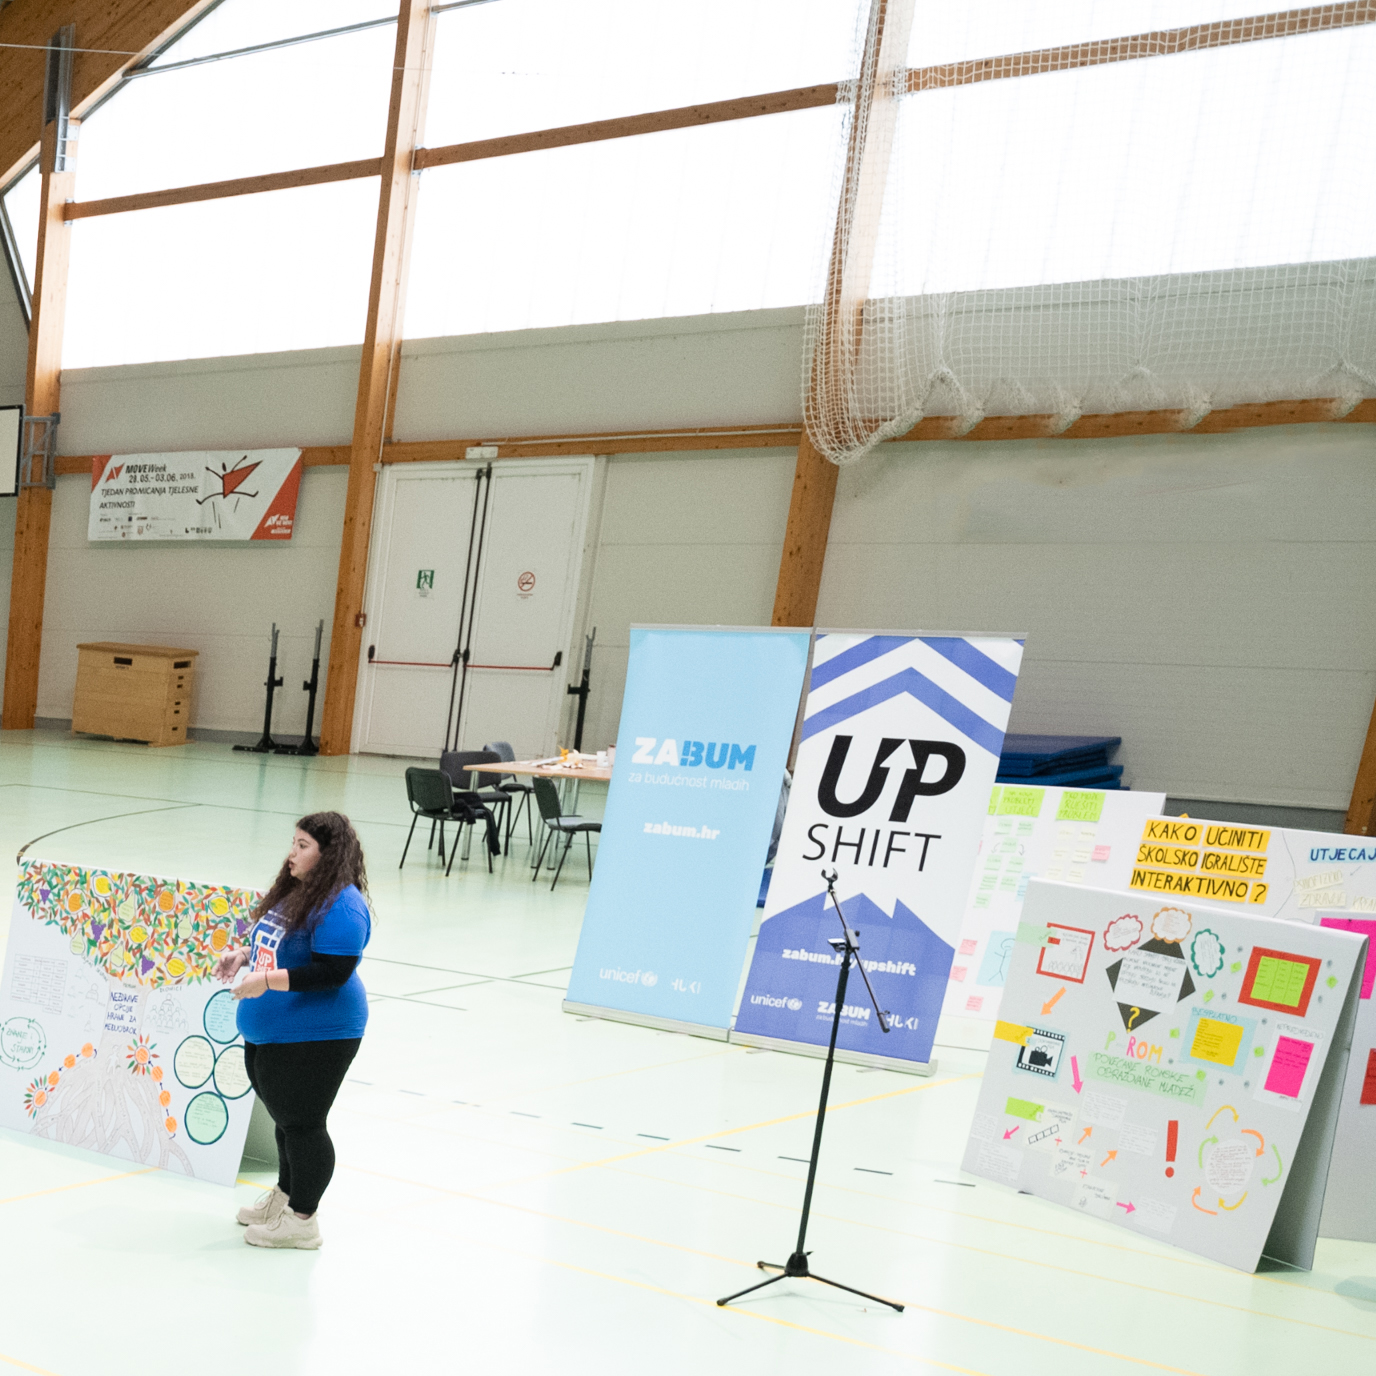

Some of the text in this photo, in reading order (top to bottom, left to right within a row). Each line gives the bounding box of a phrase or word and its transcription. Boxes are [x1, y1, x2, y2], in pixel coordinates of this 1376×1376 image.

[101, 485, 199, 498] TJEDAN PROMICANJA TJELESNE
[99, 501, 136, 509] AKTIVNOSTI
[631, 736, 757, 772] ZABUM
[627, 771, 750, 791] za budućnost mladih
[817, 734, 966, 823] UP
[643, 821, 721, 840] zabum.hr
[1148, 822, 1263, 849] KAKO UČINITI
[802, 823, 942, 872] SHIFT
[1137, 844, 1267, 876] ŠKOLSKO IGRALIŠTE
[1130, 870, 1266, 902] INTERAKTIVNO ?
[259, 952, 272, 966] UP
[599, 966, 642, 984] unicef
[750, 994, 788, 1009] unicef
